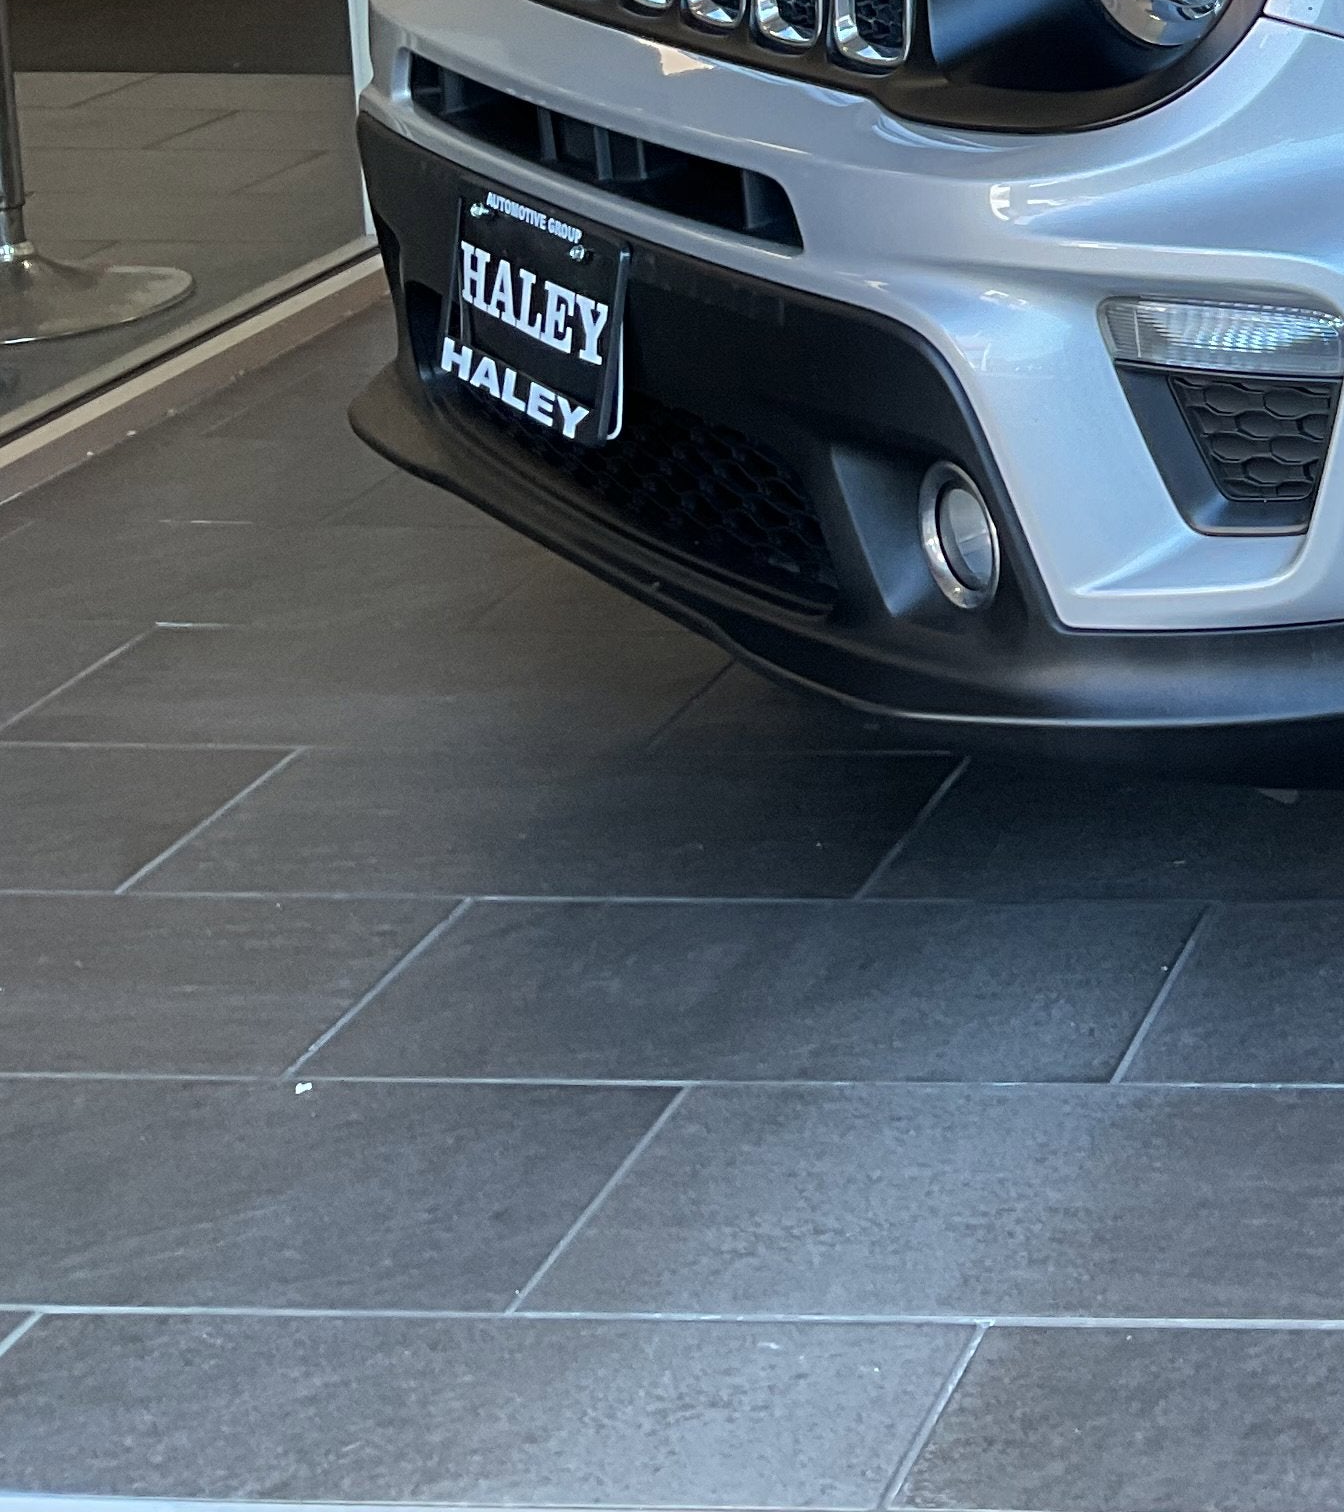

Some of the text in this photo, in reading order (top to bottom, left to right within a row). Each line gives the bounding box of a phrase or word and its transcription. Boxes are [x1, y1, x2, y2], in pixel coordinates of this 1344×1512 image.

[486, 191, 582, 243] AUTOMOTIVE GROUP
[461, 240, 609, 365] HALEY
[441, 337, 590, 439] HALEY
